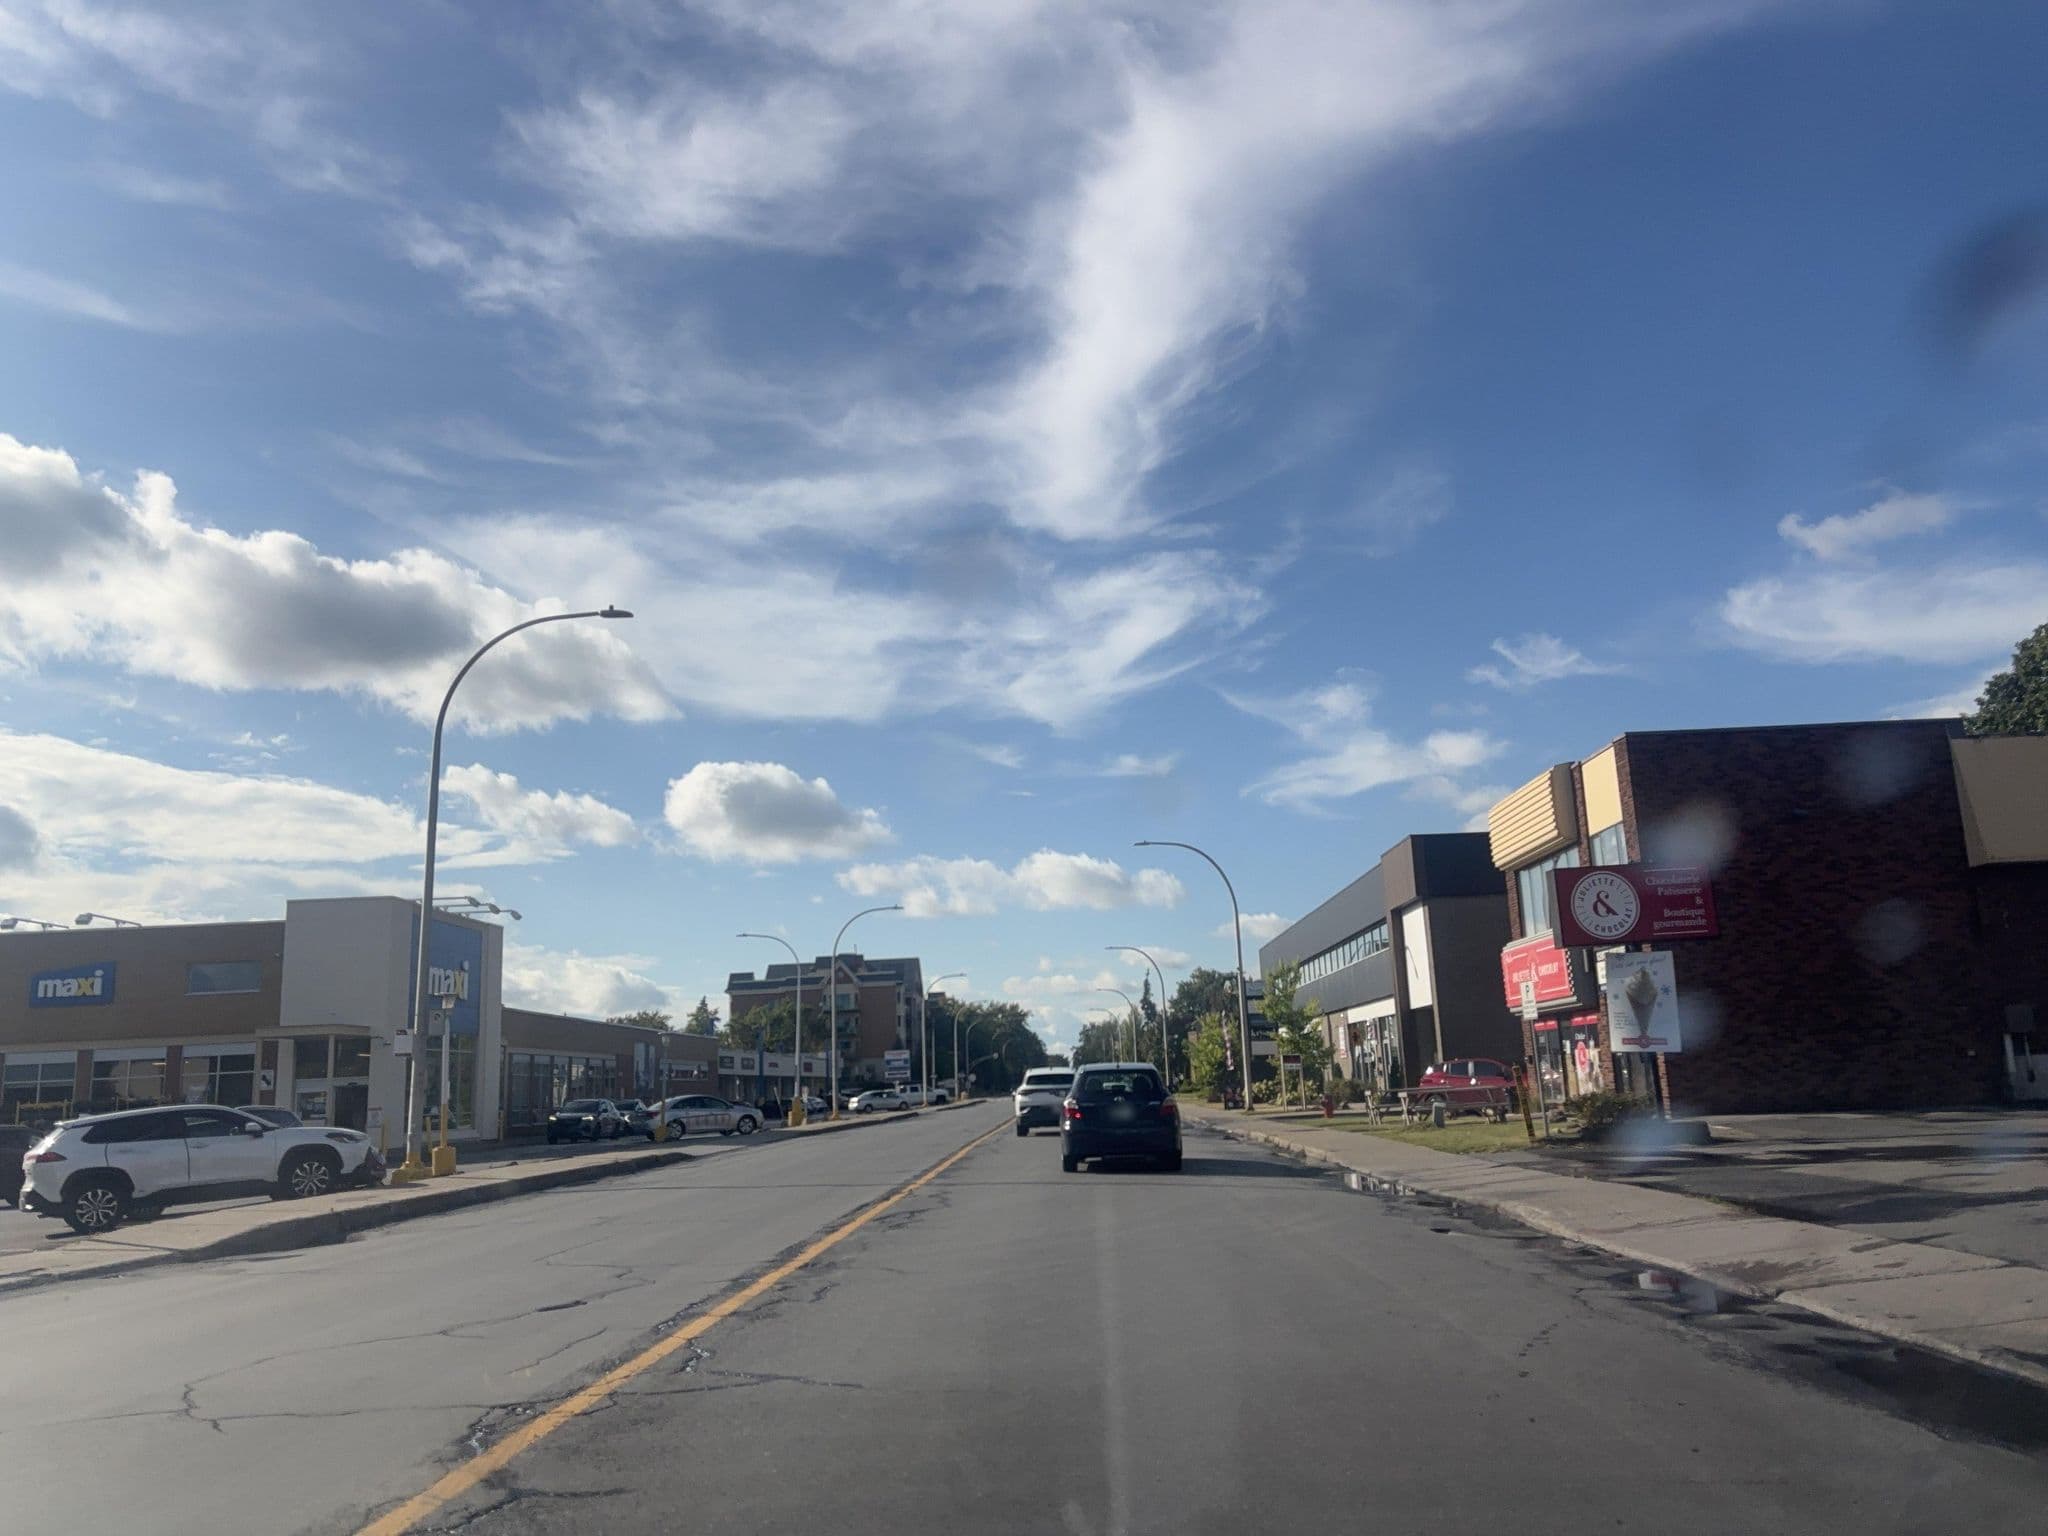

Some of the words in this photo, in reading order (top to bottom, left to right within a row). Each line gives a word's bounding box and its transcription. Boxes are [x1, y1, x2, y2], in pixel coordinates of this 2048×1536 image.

[1578, 877, 1614, 902] JULIETTE
[1696, 896, 1704, 905] &
[1592, 890, 1619, 918] &
[1663, 907, 1706, 917] Boutique
[1594, 907, 1633, 933] CHOCOLAT
[1653, 916, 1707, 930] gourmande
[37, 969, 105, 998] maxi
[428, 960, 469, 1000] maxi
